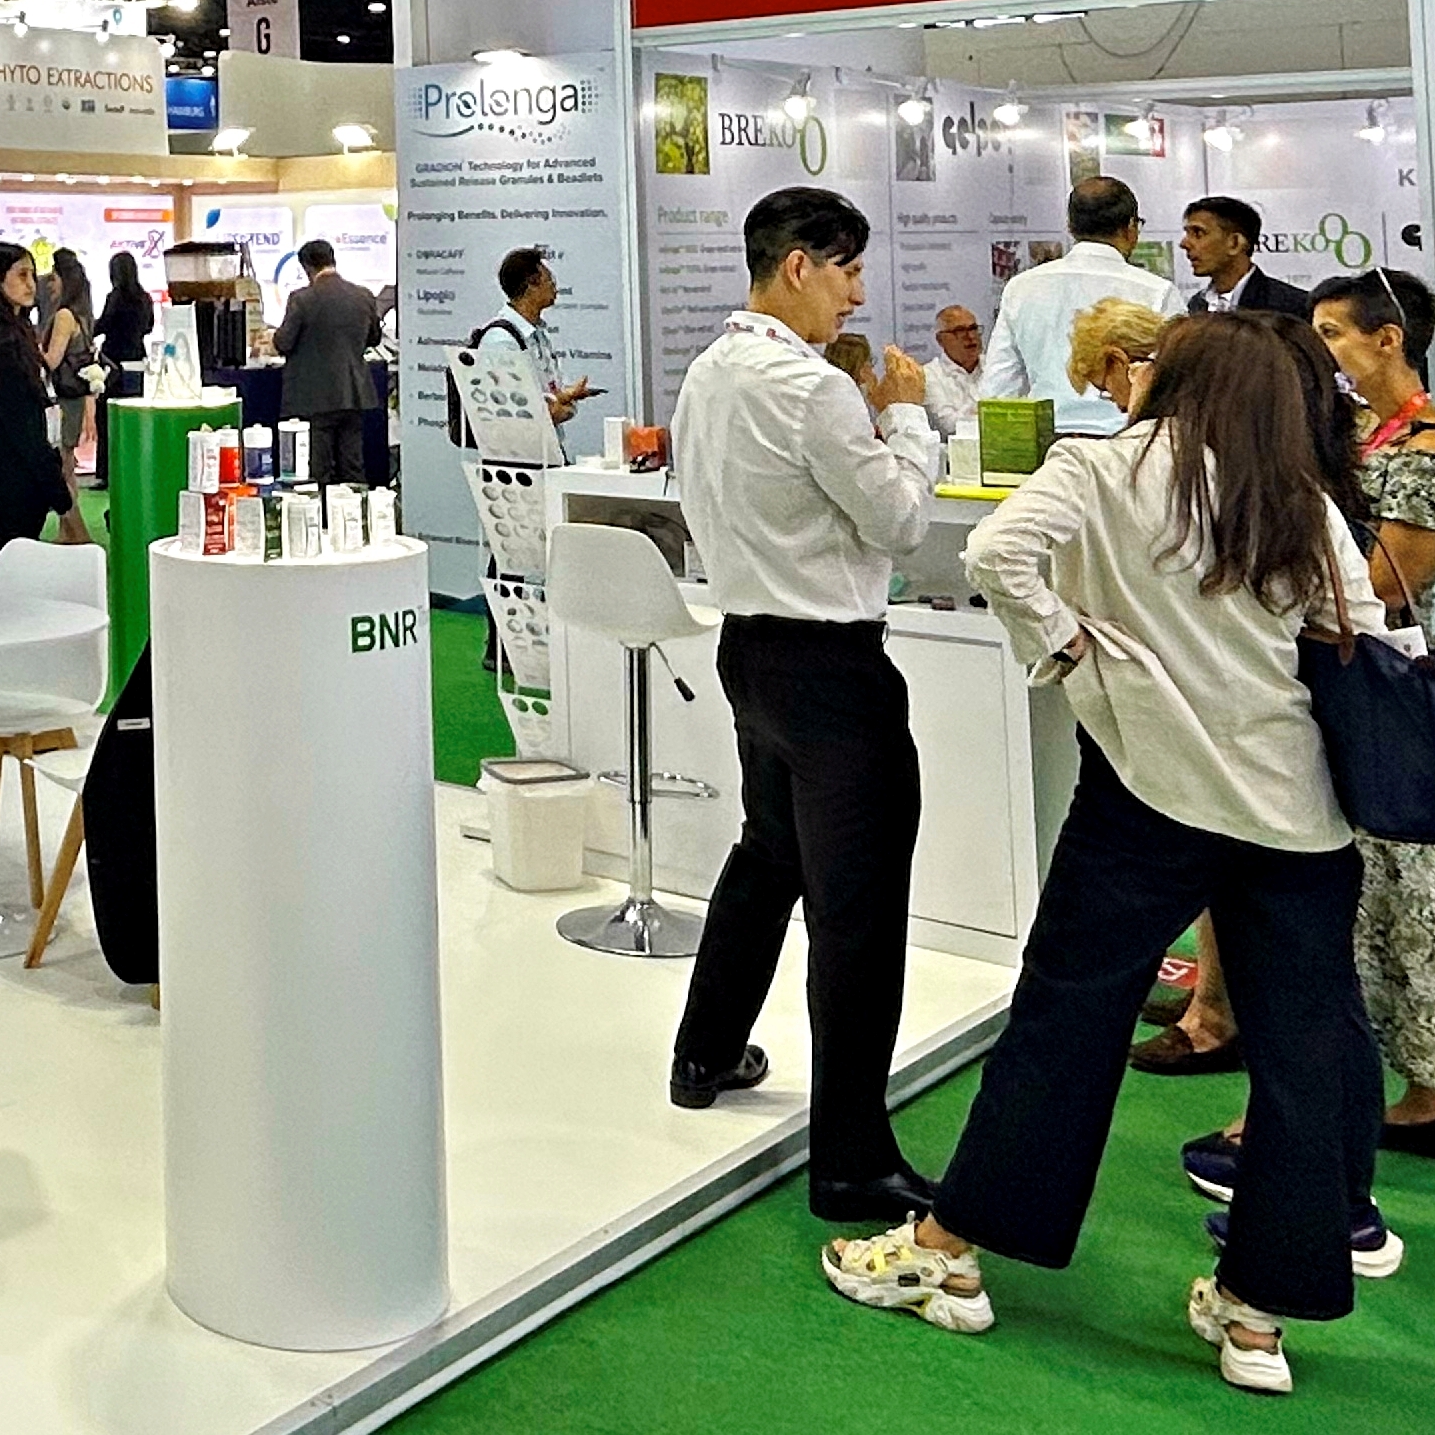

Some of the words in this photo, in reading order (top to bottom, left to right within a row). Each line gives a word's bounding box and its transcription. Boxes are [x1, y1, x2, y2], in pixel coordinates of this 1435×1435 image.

[256, 16, 272, 55] G
[47, 67, 154, 95] EXTRACTIONS
[467, 160, 524, 172] Technology
[526, 158, 541, 170] for
[543, 157, 597, 168] Advanced
[350, 608, 418, 654] BNR
